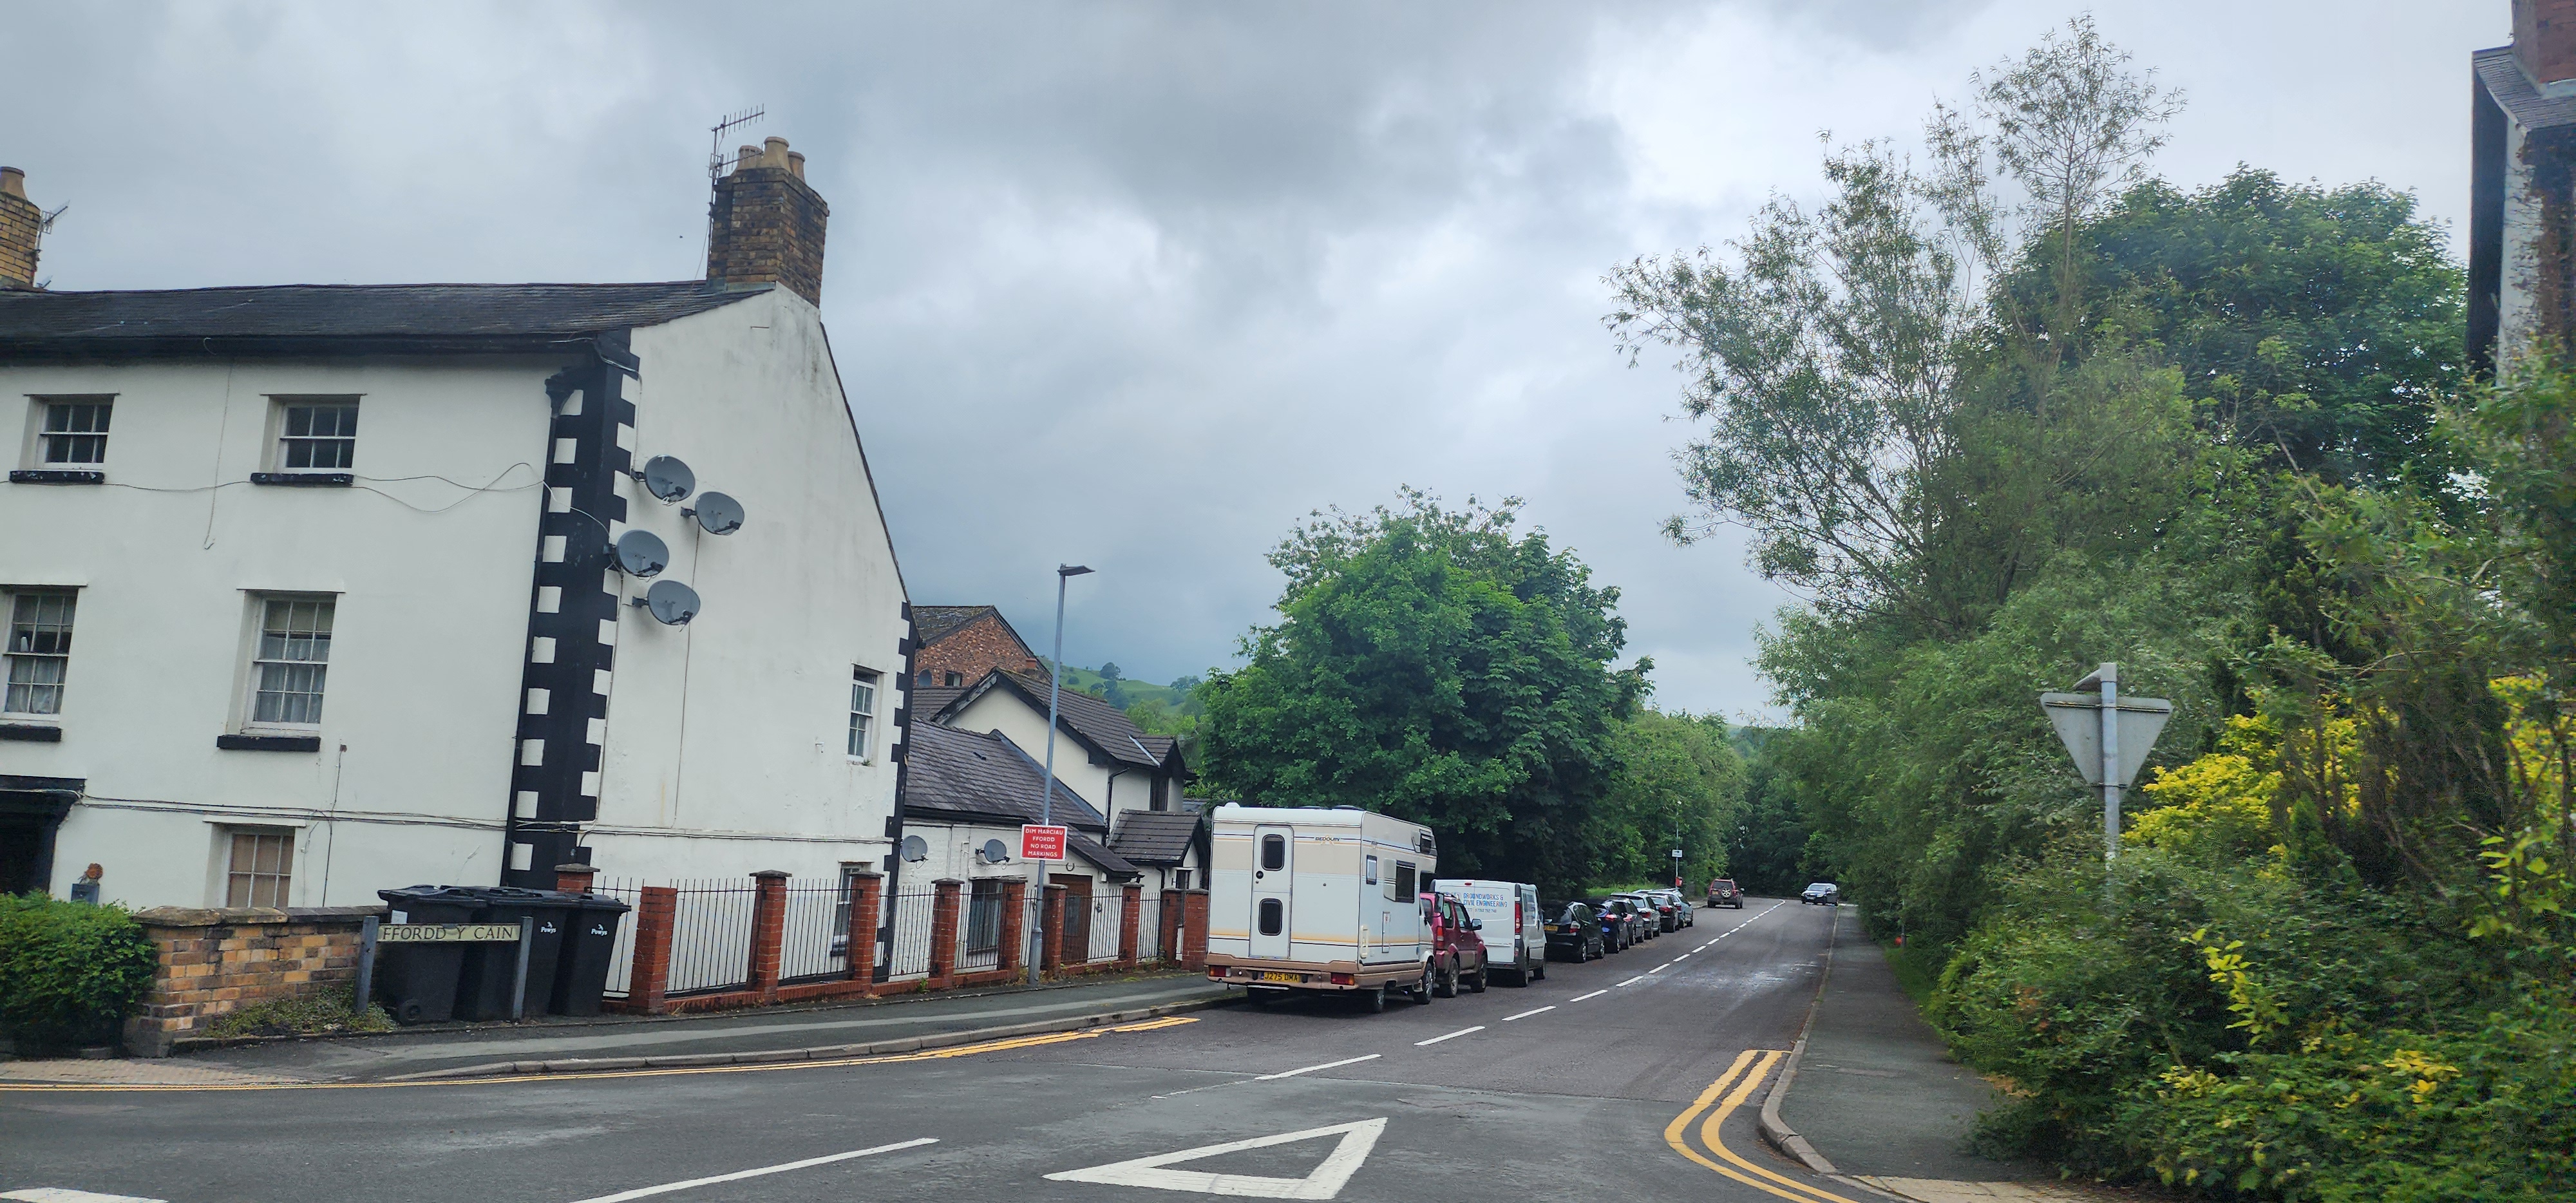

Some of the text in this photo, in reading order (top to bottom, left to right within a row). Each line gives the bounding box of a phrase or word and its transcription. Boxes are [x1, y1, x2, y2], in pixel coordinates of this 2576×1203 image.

[383, 927, 514, 940] FFORDD Y CAIN
[1264, 972, 1282, 981] J275
